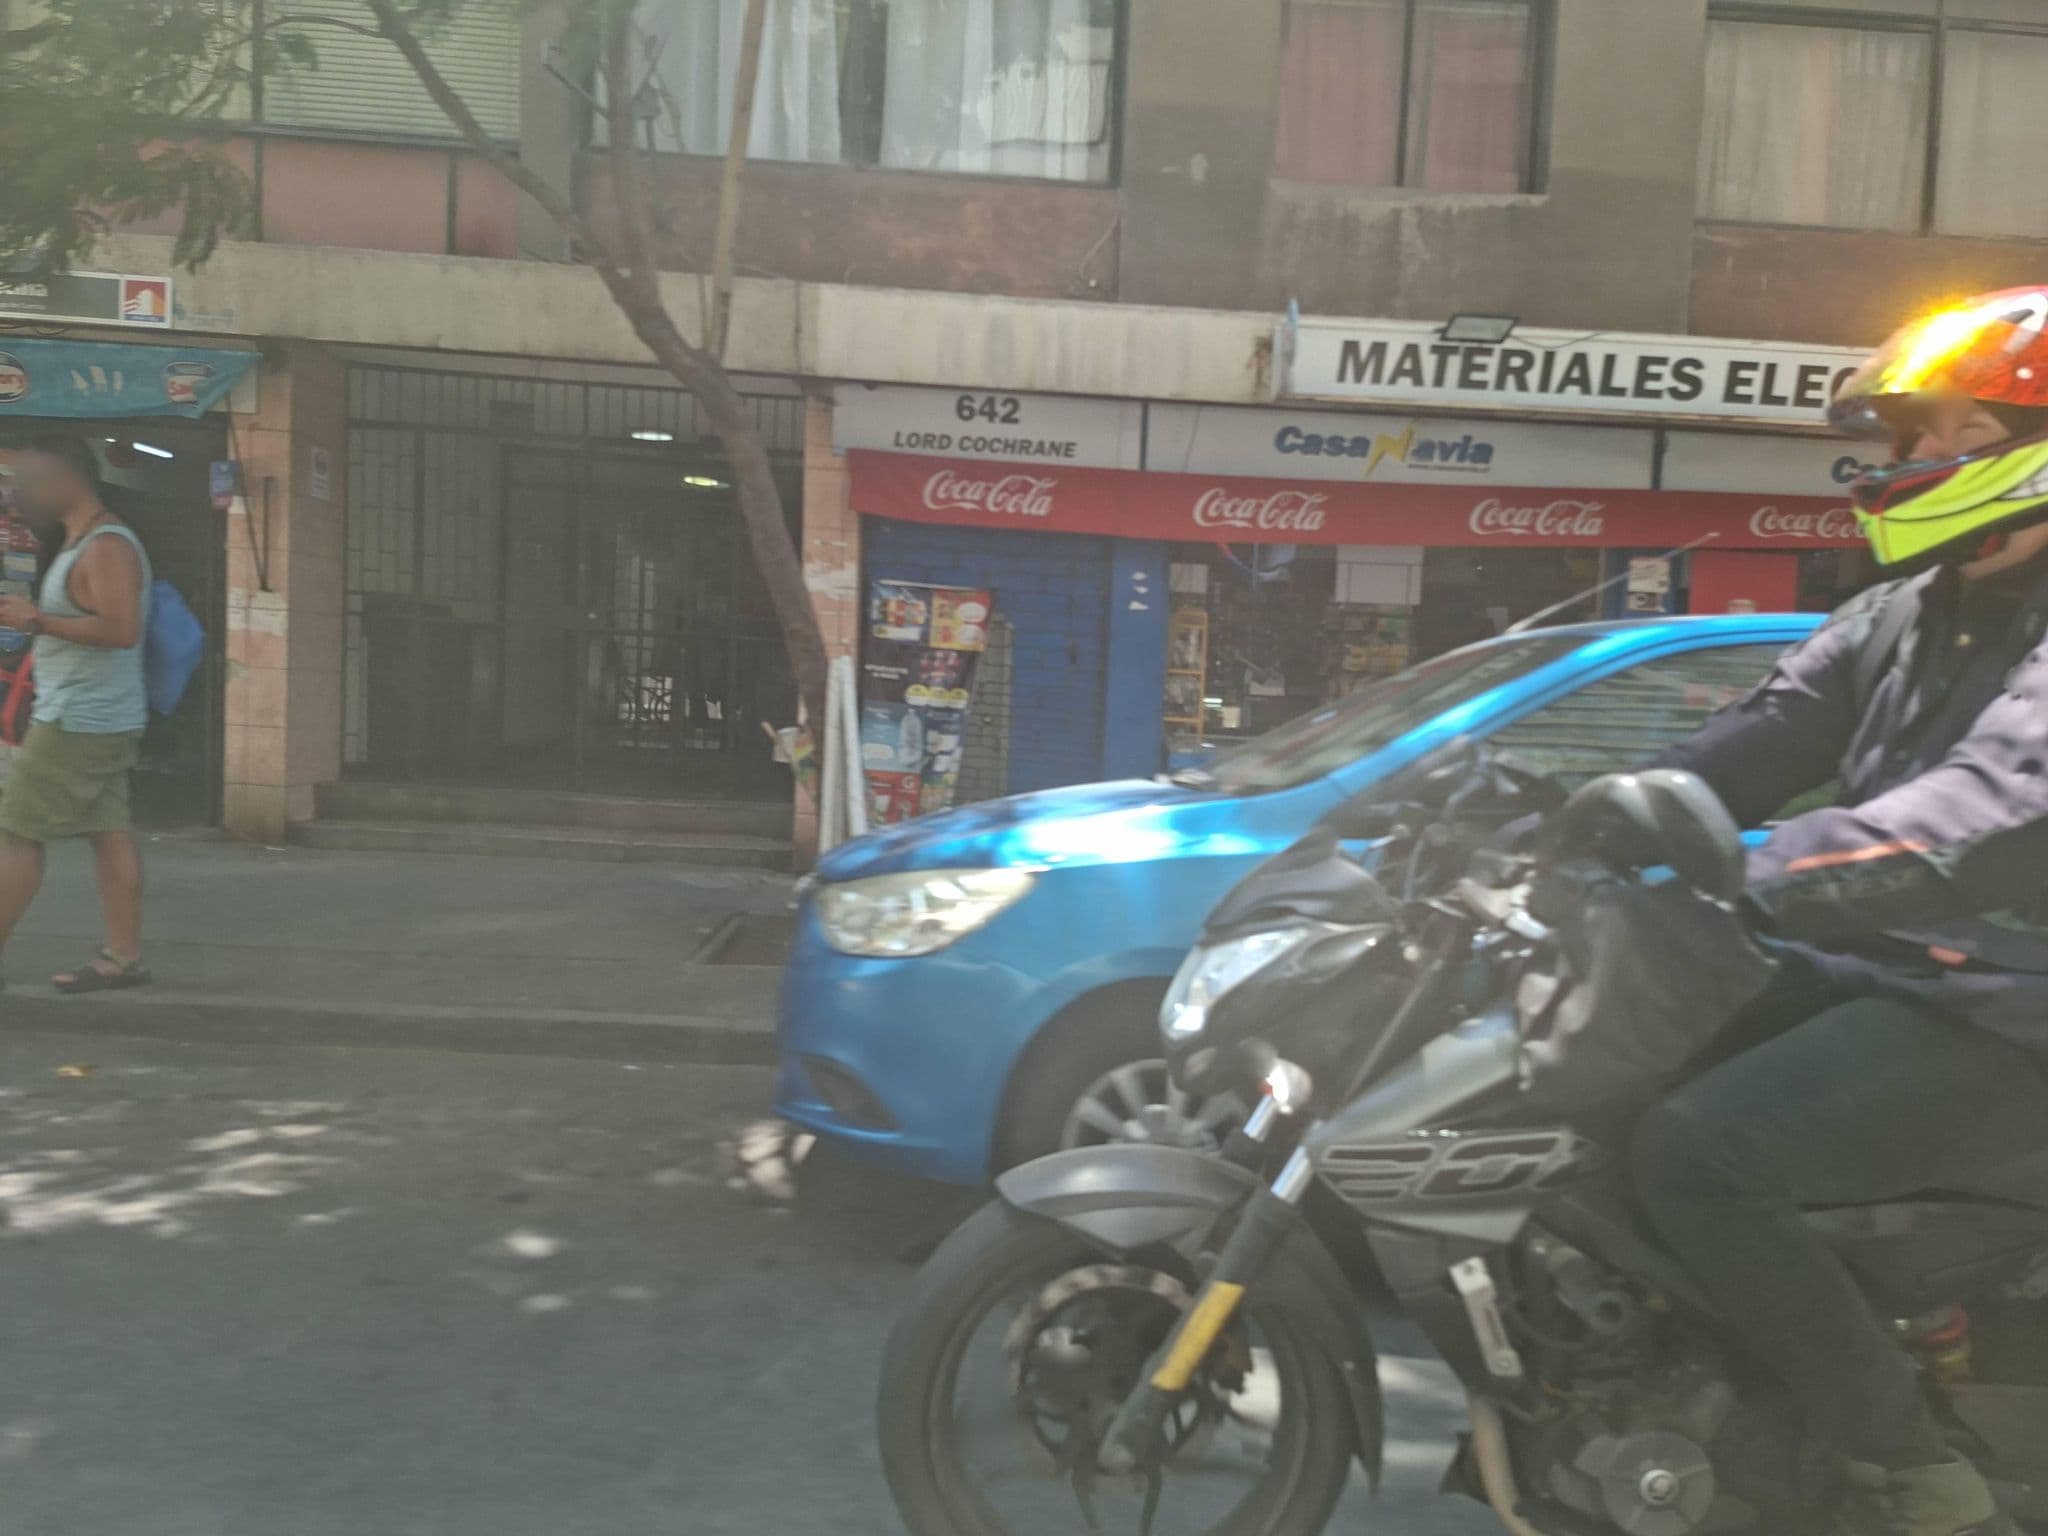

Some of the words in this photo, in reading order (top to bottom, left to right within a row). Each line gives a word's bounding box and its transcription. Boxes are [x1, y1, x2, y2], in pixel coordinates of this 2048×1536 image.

[1337, 339, 1705, 402] MATERIALES
[956, 395, 1021, 424] 642
[893, 431, 952, 450] LORD
[958, 435, 1077, 458] COCHRANE
[922, 469, 1058, 517] Coca-Cola
[1193, 487, 1330, 532] Coca-Cola
[1469, 498, 1607, 537] Coca-Cola
